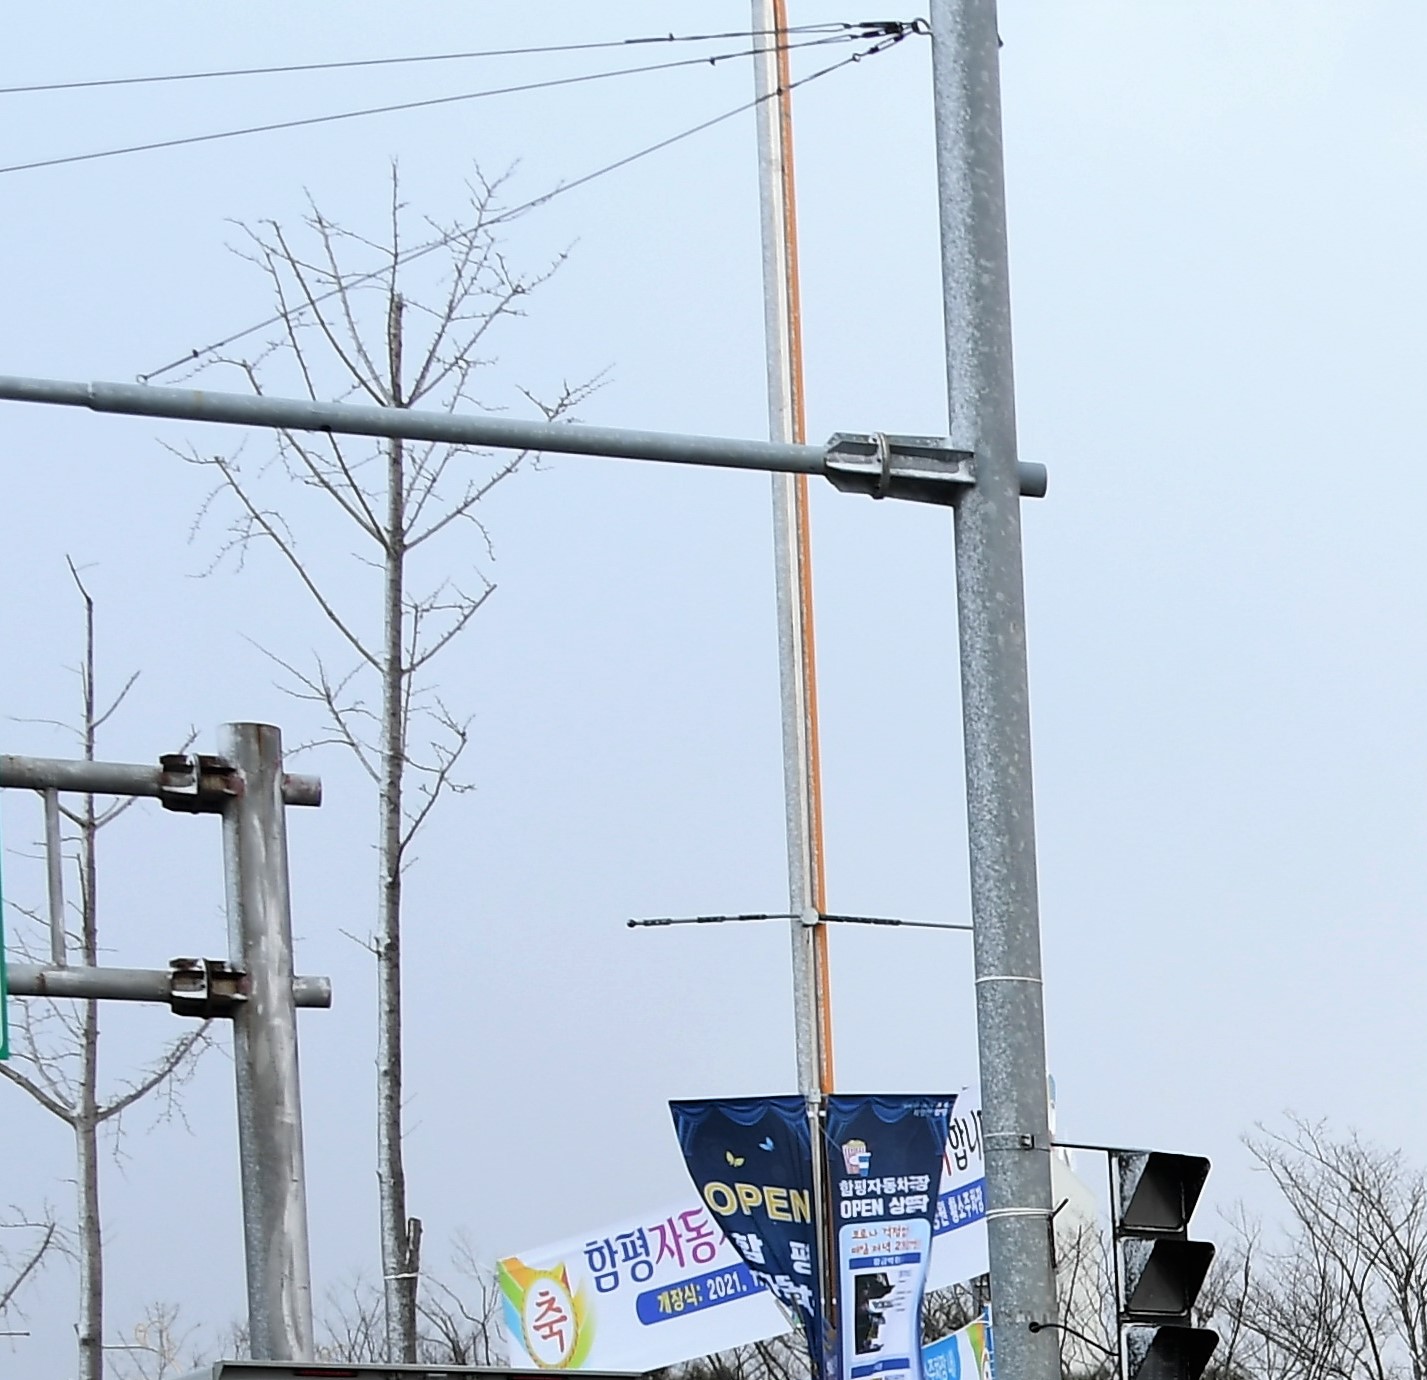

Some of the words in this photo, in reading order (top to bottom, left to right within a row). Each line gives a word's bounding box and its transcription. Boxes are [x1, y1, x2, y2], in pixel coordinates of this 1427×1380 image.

[705, 1181, 811, 1224] OPEN
[840, 1197, 884, 1219] OPEN
[706, 1270, 748, 1301] 2021.
[532, 1290, 568, 1353] 축
